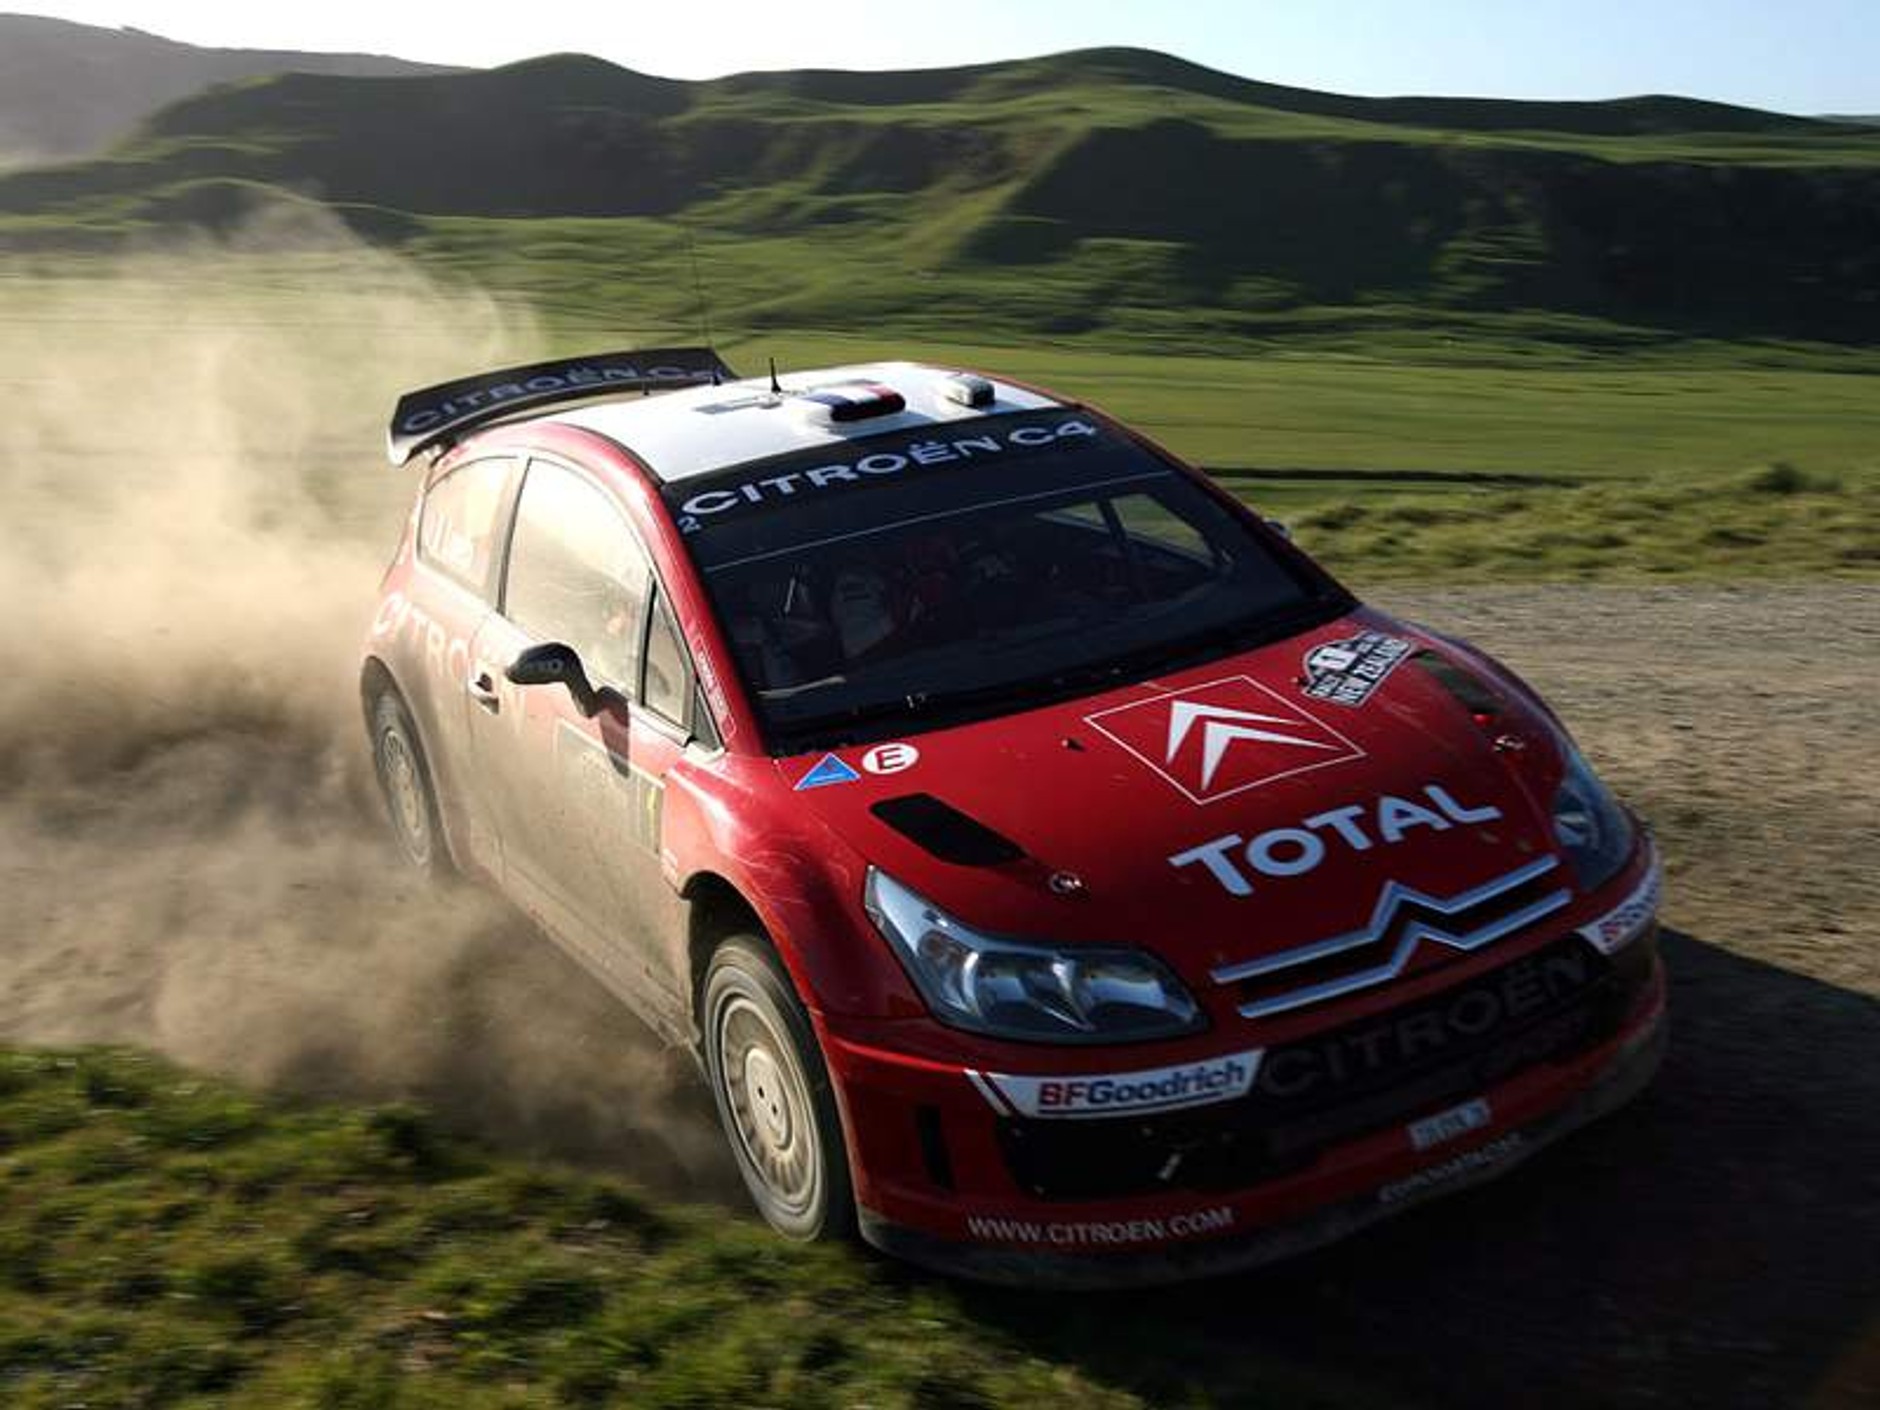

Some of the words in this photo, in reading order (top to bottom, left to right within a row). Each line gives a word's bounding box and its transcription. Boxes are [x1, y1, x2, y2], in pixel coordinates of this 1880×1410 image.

[403, 364, 638, 432] CITROËN
[681, 436, 1002, 515] CITROËN
[1008, 420, 1097, 446] C4
[874, 746, 907, 772] E
[1169, 785, 1502, 896] TOTAL
[1262, 960, 1587, 1096] CITROËN
[1038, 1059, 1246, 1108] BFGoodrich
[967, 1206, 1234, 1244] WWW.CITROEN.COM
